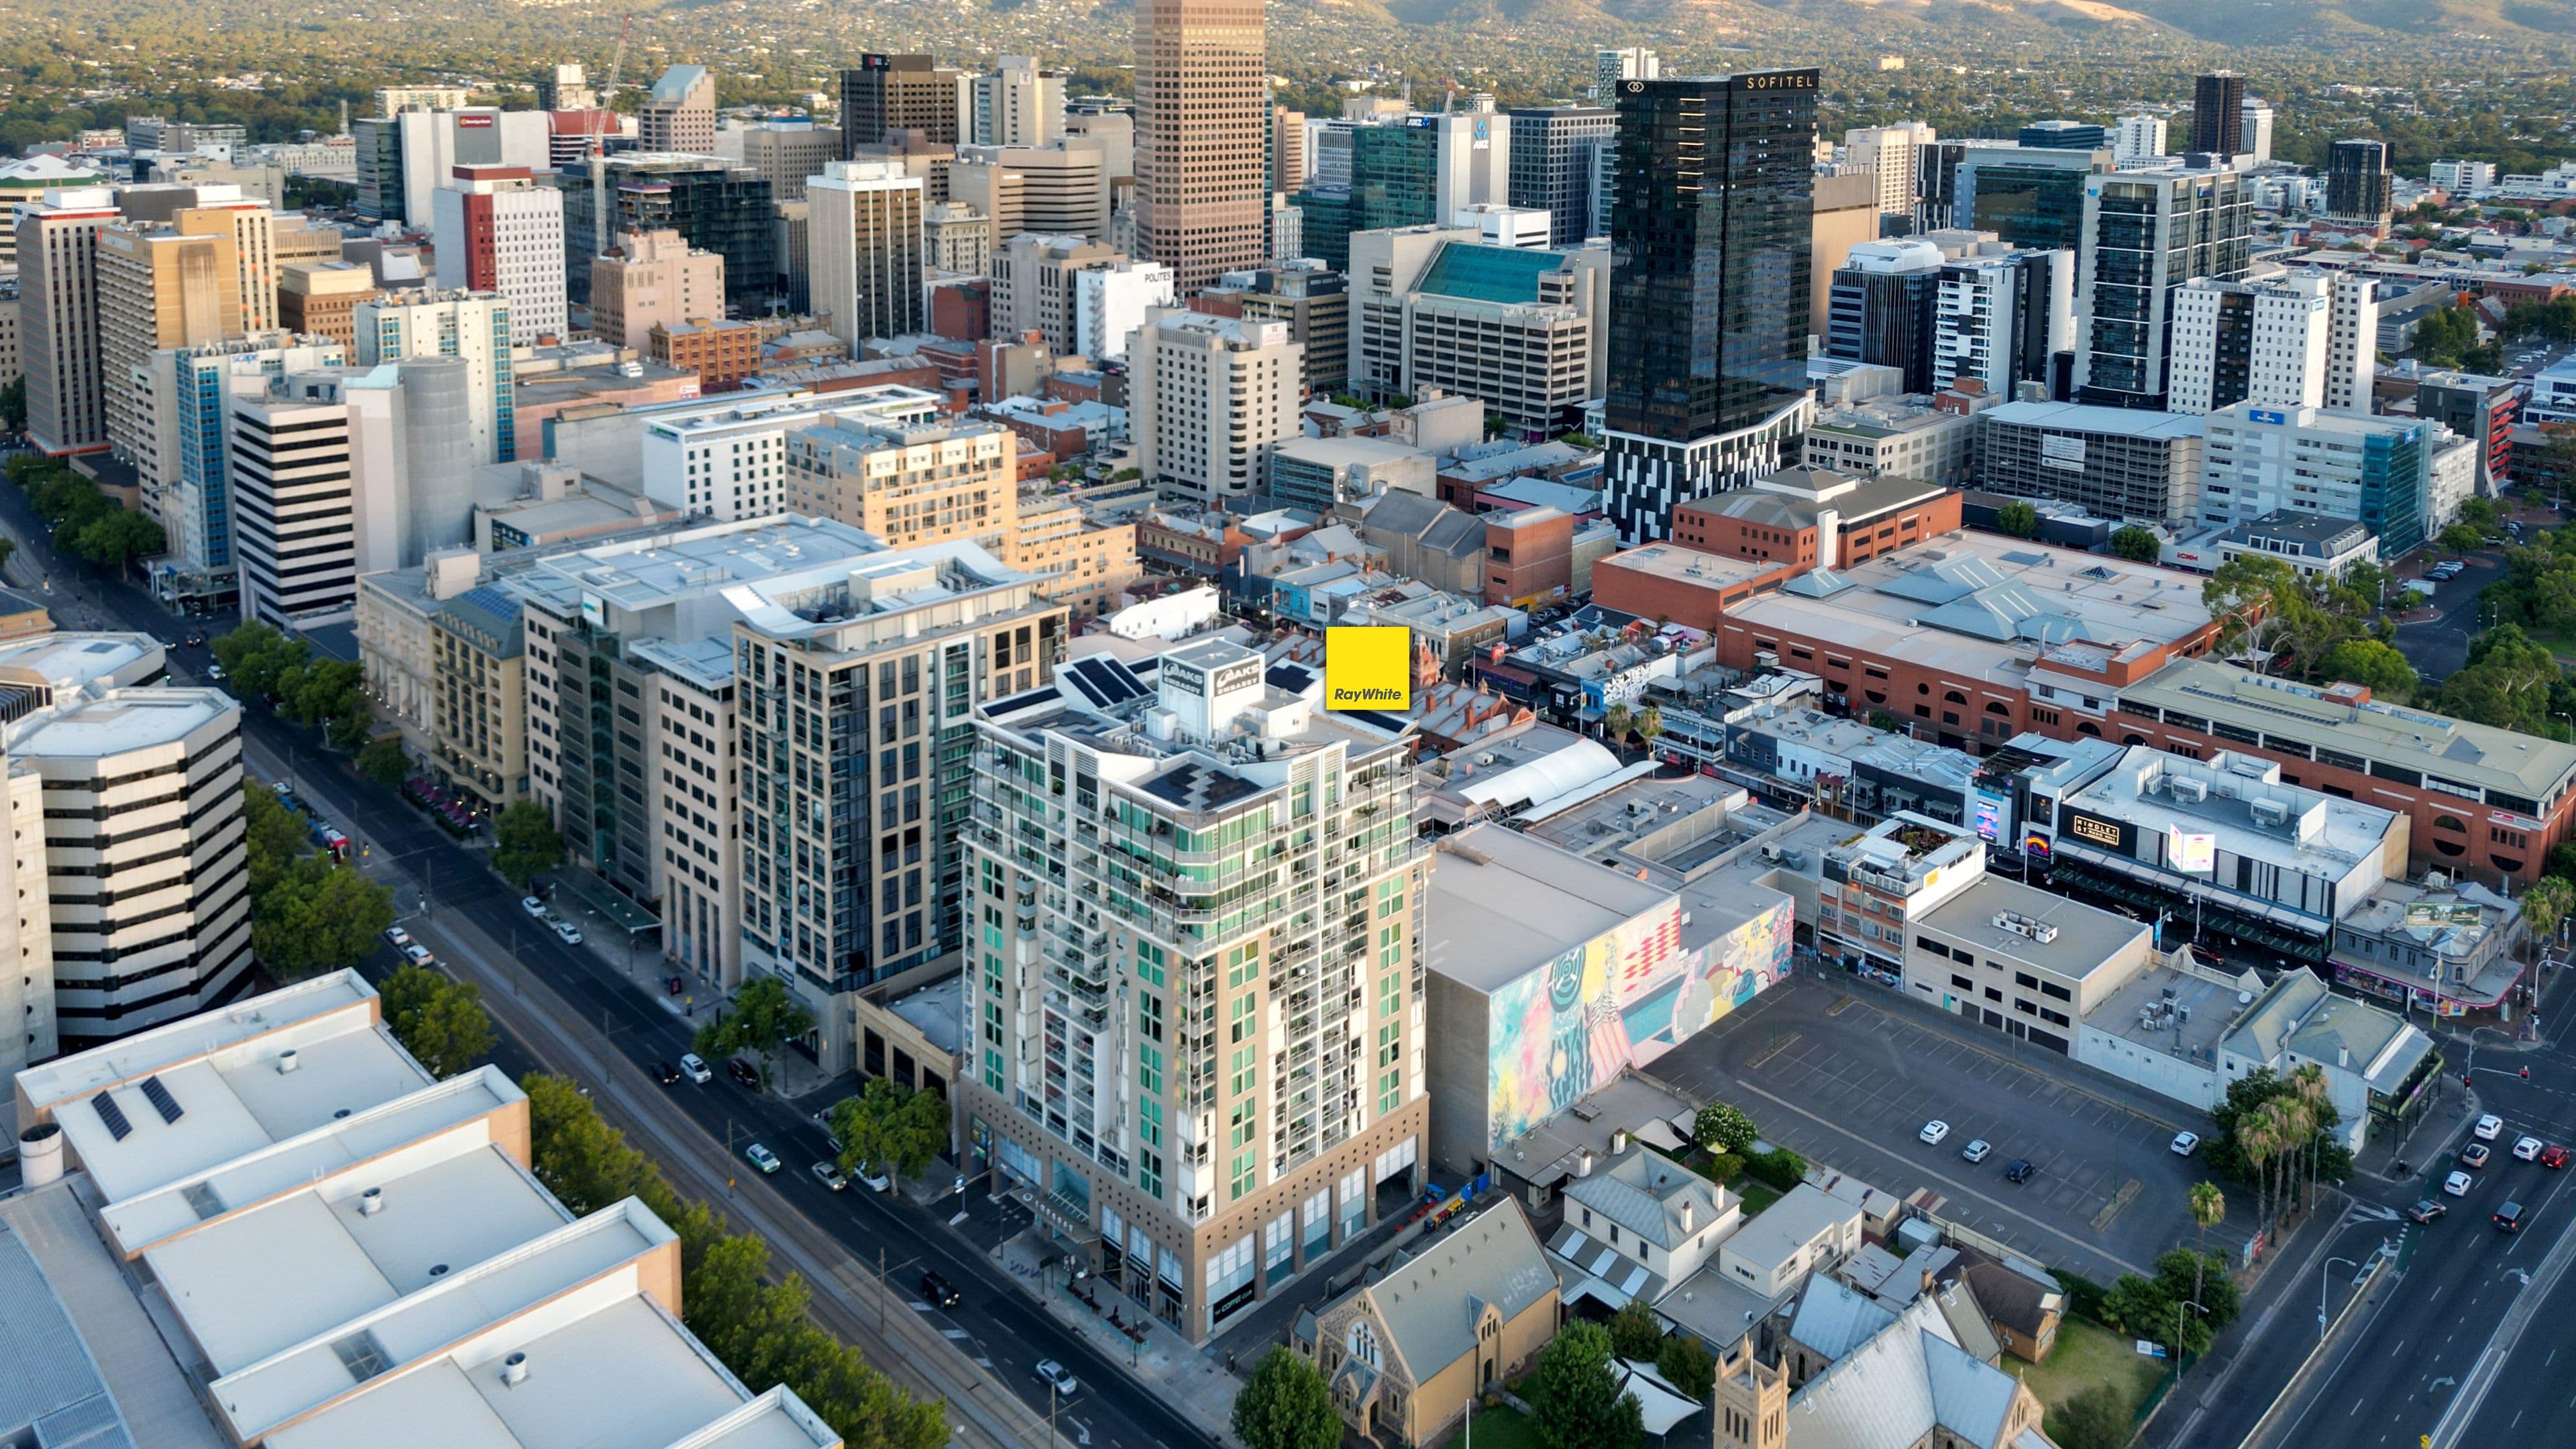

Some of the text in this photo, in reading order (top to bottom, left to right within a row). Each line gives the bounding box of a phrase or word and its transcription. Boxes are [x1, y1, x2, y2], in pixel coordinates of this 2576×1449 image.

[1747, 76, 1813, 89] SOFITEL
[1407, 118, 1423, 126] ANZ
[1473, 140, 1489, 150] ANZ
[1144, 271, 1171, 283] POLITES
[1164, 677, 1201, 694] EMBASSY
[1218, 677, 1257, 694] EMBASSY
